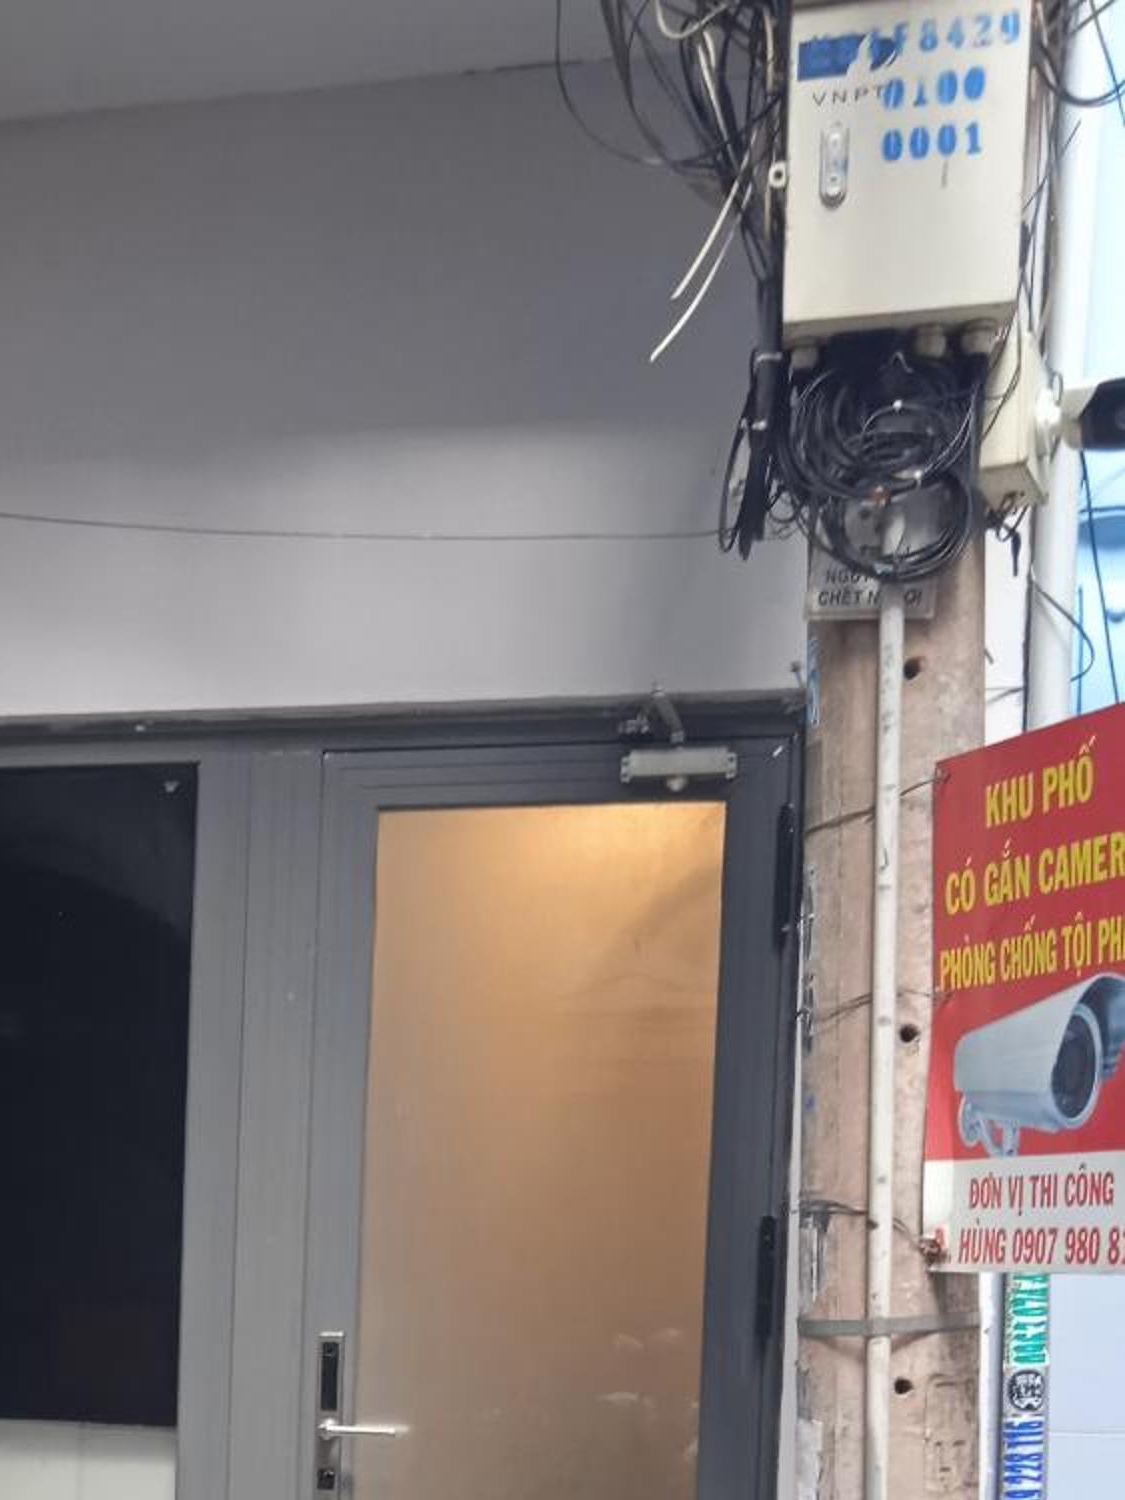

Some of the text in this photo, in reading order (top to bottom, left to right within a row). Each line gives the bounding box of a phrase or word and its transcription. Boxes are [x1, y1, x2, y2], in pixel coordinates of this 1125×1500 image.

[883, 65, 986, 109] 0100
[882, 120, 982, 161] 0001
[985, 735, 1097, 829] KHU PHỐ
[945, 855, 976, 916] CÓ
[984, 838, 1032, 907] GẮN
[1000, 913, 1058, 981] CHỐNG
[1061, 910, 1092, 977] TỘI
[1008, 1174, 1024, 1216] VỊ
[1029, 1173, 1057, 1208] THI
[1064, 1162, 1115, 1208] CÔNG
[1012, 1227, 1059, 1265] 0907
[1065, 1226, 1101, 1265] 980
